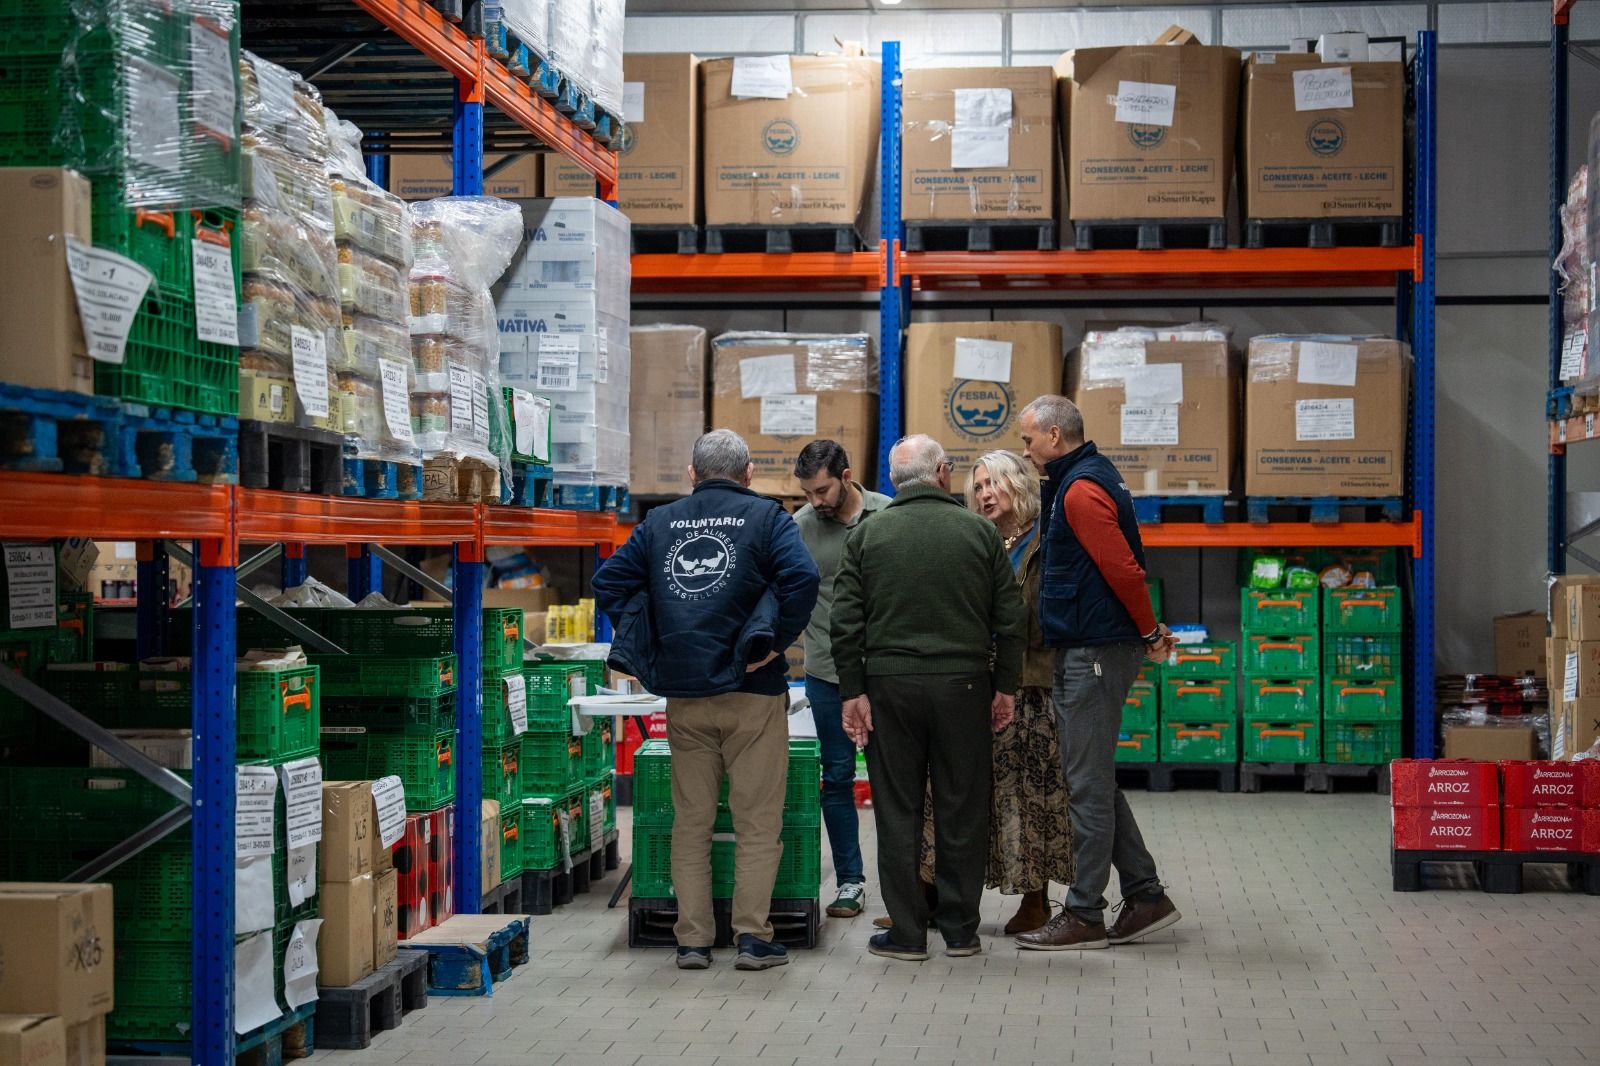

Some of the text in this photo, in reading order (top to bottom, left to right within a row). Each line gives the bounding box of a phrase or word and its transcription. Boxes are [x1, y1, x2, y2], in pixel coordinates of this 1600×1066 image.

[1084, 166, 1136, 174] CONSERVAS
[1142, 165, 1174, 173] ACEITE
[776, 172, 806, 180] ACEITE
[813, 172, 840, 180] LECHE
[1263, 173, 1314, 181] CONSERVAS
[1192, 196, 1216, 204] Kappa
[1018, 204, 1042, 212] Kappa
[1368, 201, 1392, 210] Kappa
[524, 228, 547, 241] IVA
[959, 392, 1000, 400] FESBAL
[424, 474, 440, 485] PAL
[670, 517, 745, 529] VOLUNTARIO
[664, 528, 736, 573] BANCO DE ALIMENTOS
[669, 580, 726, 600] CASTELLON
[1428, 783, 1470, 793] ARROZ
[1532, 785, 1574, 795] ARROZ
[1430, 826, 1472, 836] ARROZ
[1531, 829, 1573, 839] ARROZ
